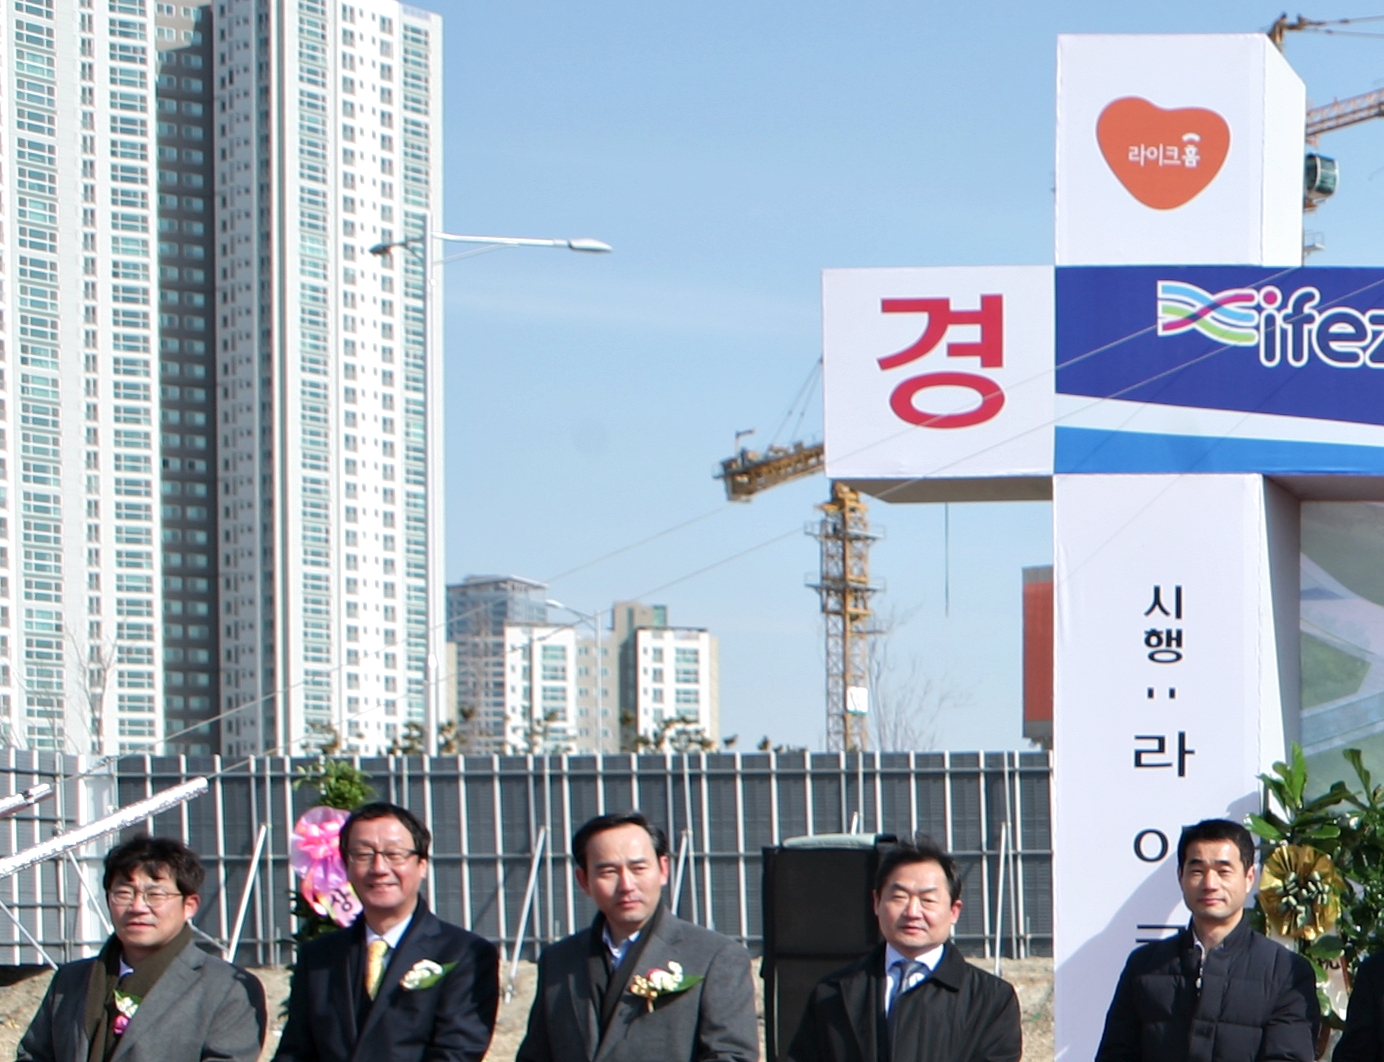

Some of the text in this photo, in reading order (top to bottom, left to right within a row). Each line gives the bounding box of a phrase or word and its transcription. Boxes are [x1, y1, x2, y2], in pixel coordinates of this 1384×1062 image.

[1128, 142, 1202, 168] 라이크홈
[879, 294, 1005, 429] 경
[1143, 585, 1183, 664] 시행
